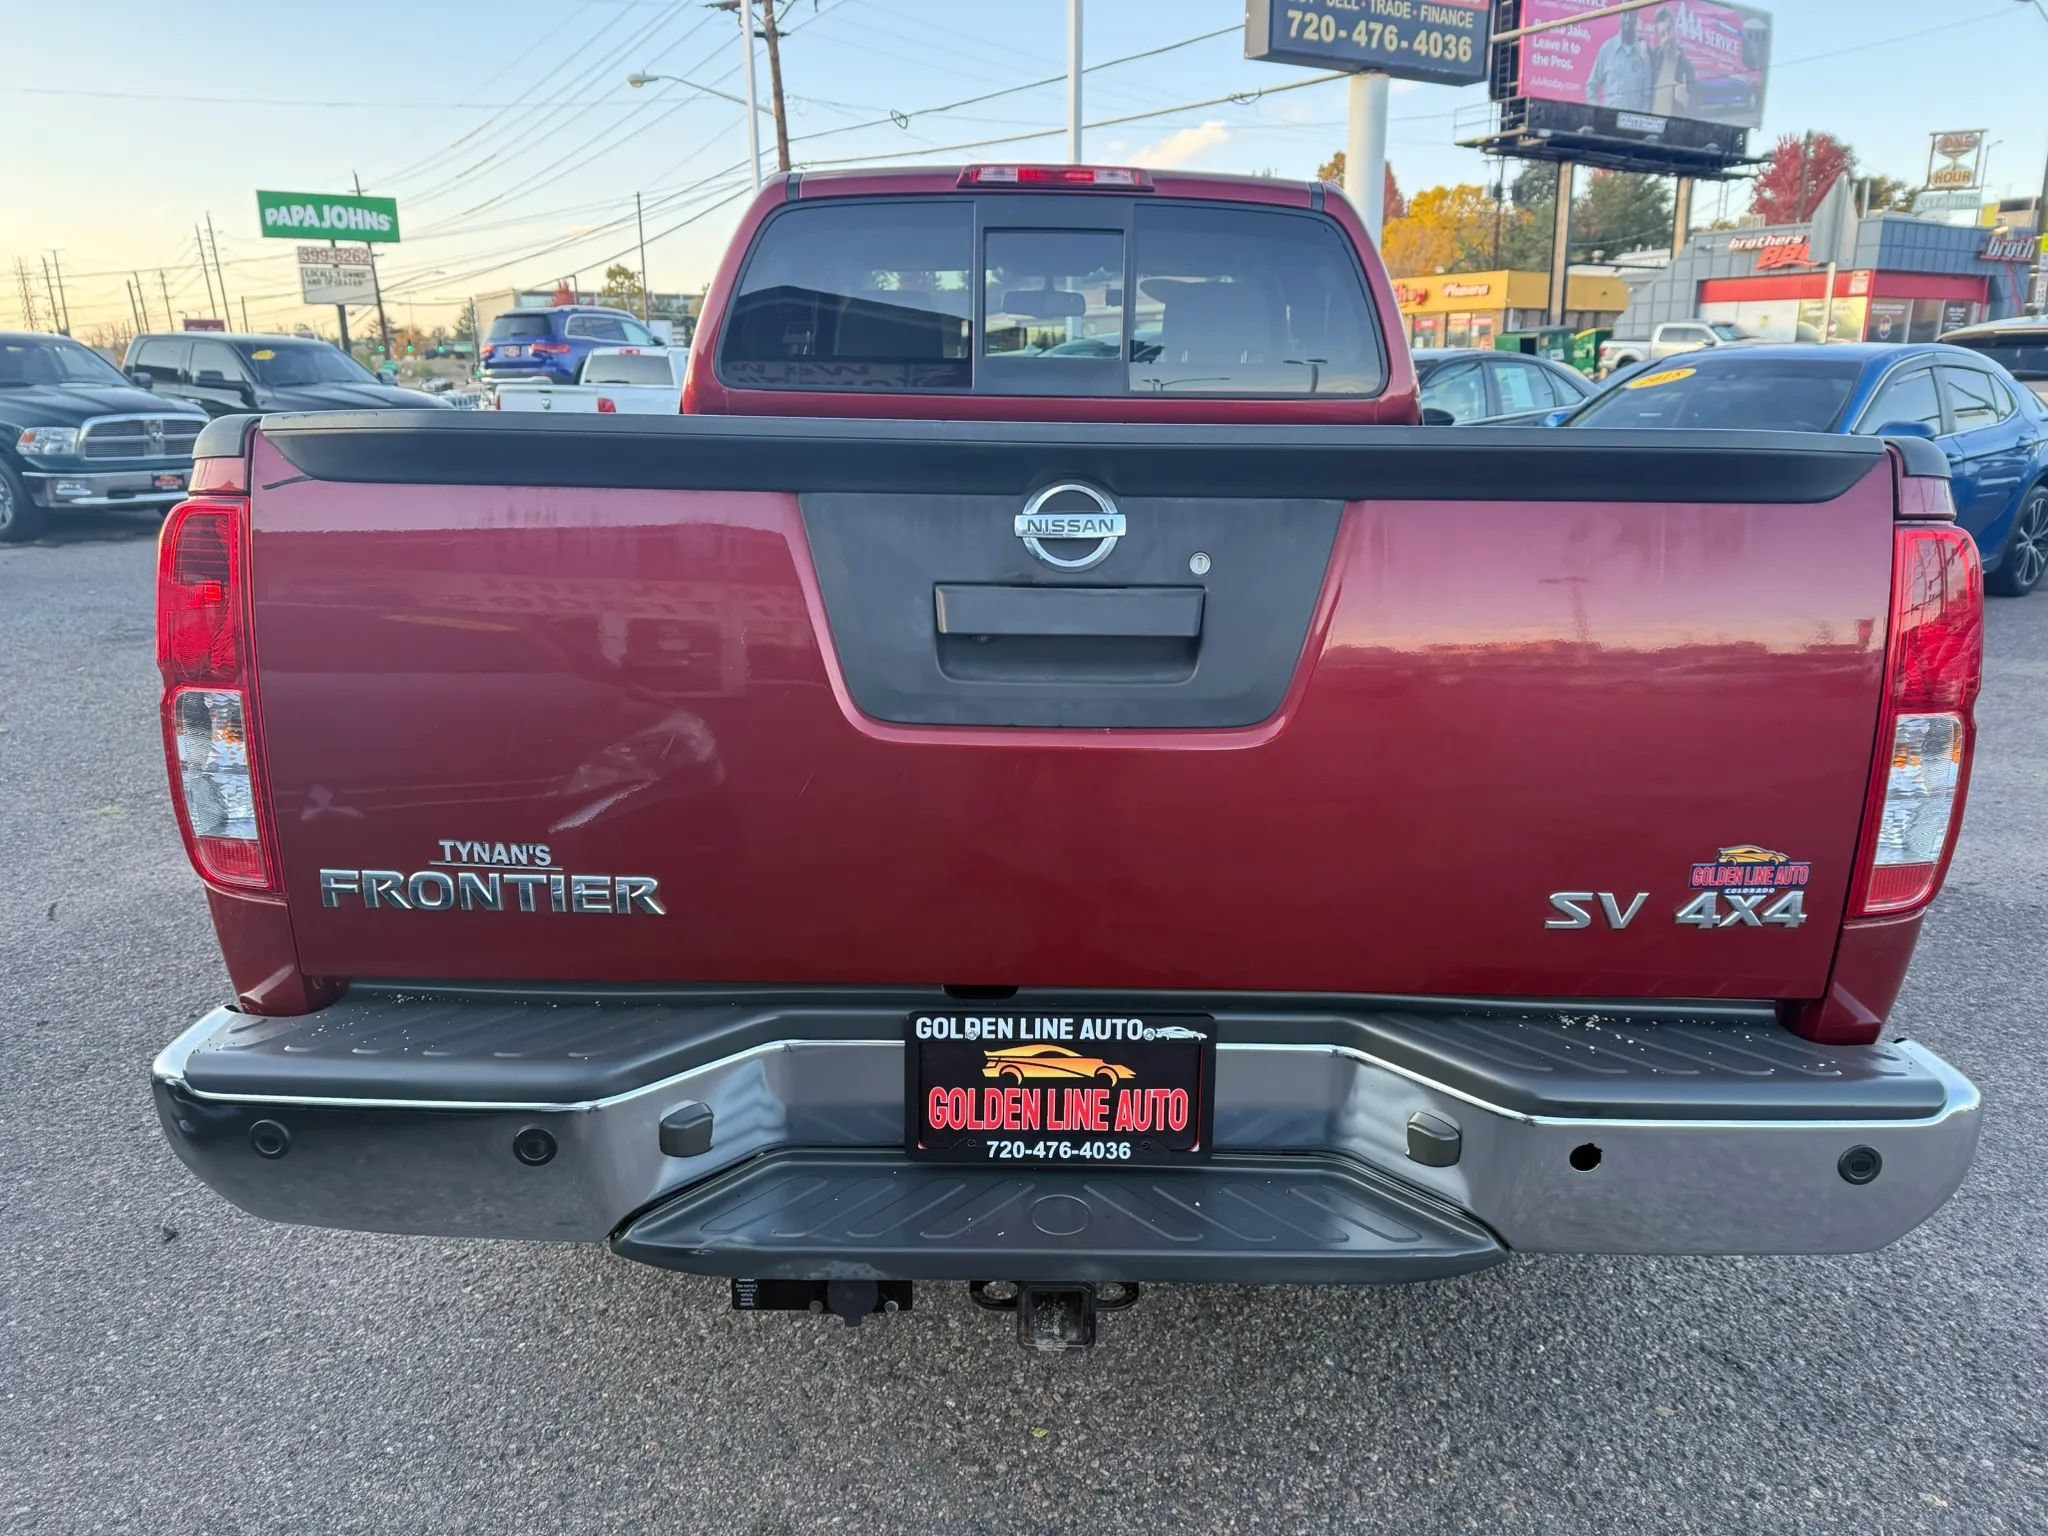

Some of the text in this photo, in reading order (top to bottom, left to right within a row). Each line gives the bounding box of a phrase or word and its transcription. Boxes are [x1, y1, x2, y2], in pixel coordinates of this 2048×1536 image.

[1369, 0, 1411, 19] TRADE
[1420, 5, 1474, 28] FINANCE
[1287, 9, 1473, 62] 720-476-4036
[1532, 35, 1560, 53] Leave
[1532, 53, 1550, 66] the
[1935, 171, 1971, 184] HOUR
[265, 204, 390, 231] PAPA JOHNS
[1729, 235, 1806, 249] brothers
[1986, 236, 2035, 259] broth
[301, 248, 370, 263] 399-6262
[1027, 518, 1115, 533] NISSAN
[438, 839, 552, 867] TYNAN'S
[1692, 865, 1810, 886] GOLDEN LINE AUTO
[319, 868, 666, 915] FRONTIER
[1724, 887, 1775, 895] COLORADO
[1544, 892, 1650, 929] SV
[1674, 890, 1808, 929] 4X4
[915, 1016, 1143, 1041] GOLDEN LINE AUTO
[928, 1086, 1189, 1132] GOLDEN LINE AUTO
[986, 1140, 1131, 1160] 720-476-4036
